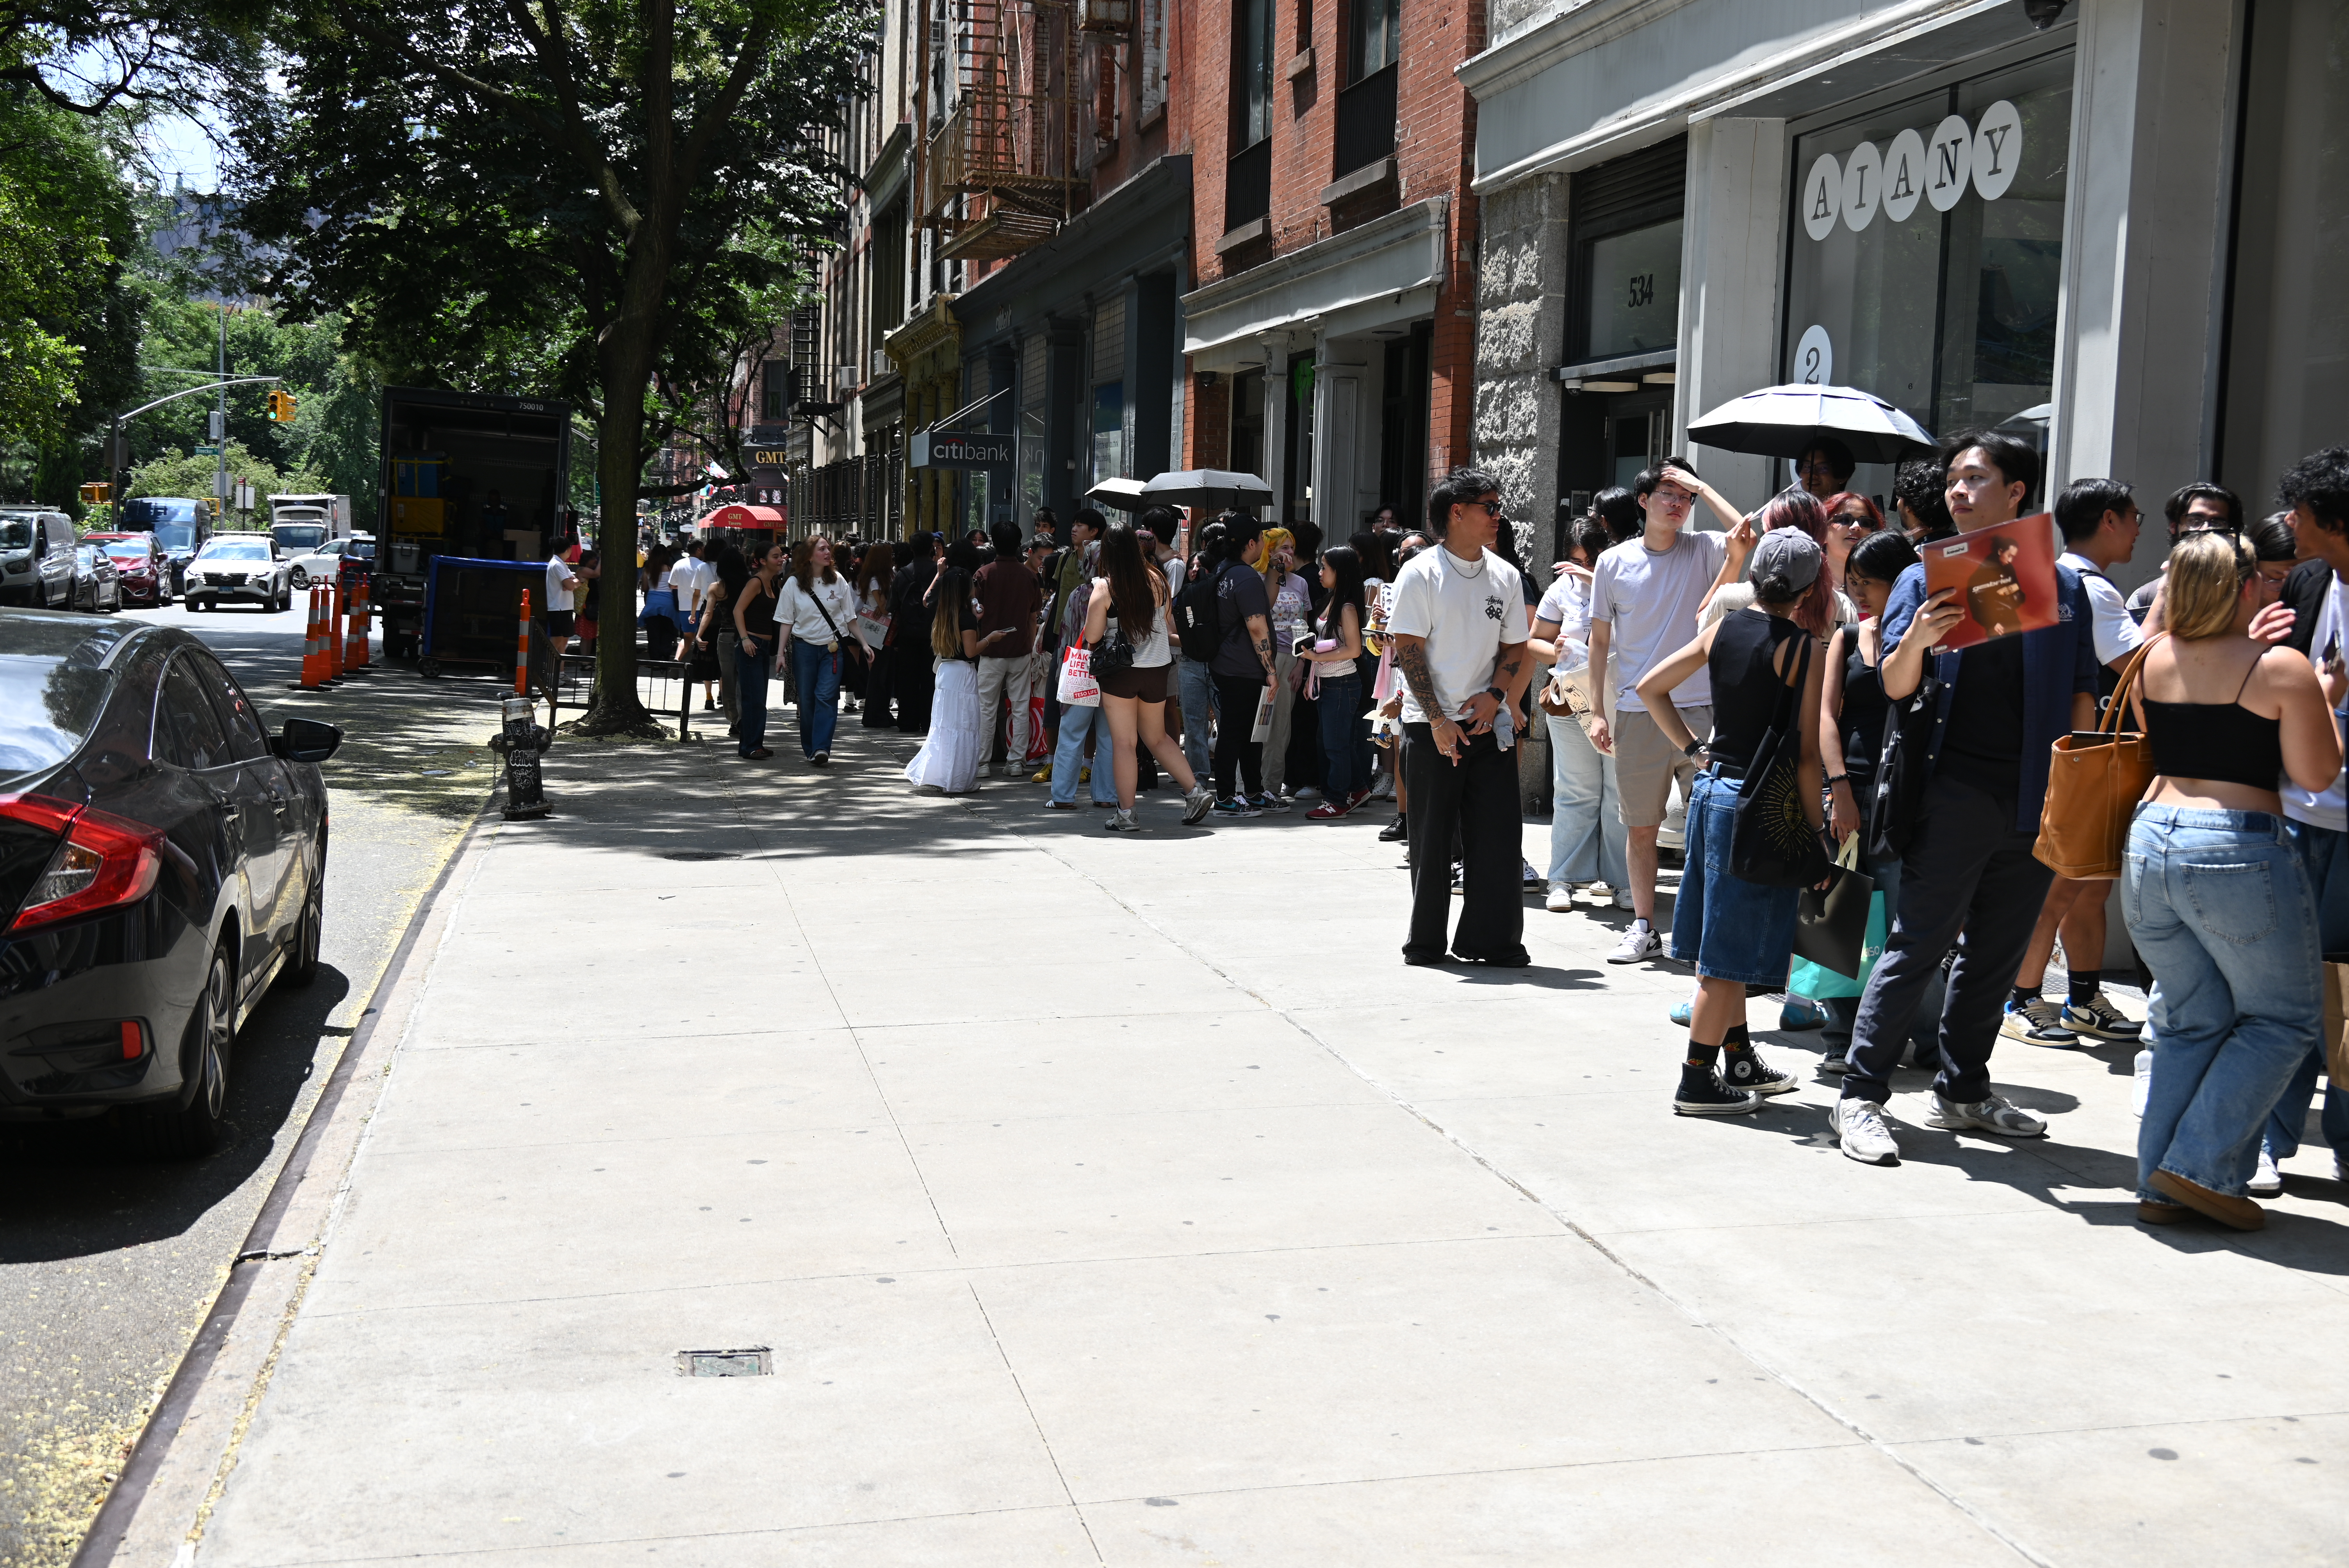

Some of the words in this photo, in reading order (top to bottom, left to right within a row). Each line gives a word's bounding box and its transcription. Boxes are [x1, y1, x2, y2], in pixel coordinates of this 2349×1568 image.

[1811, 124, 2011, 220] AIANY
[1628, 274, 1654, 308] 534
[1805, 347, 1820, 385] 2
[519, 402, 544, 412] 750010
[756, 451, 786, 464] GMT
[933, 442, 1008, 461] citibank
[1071, 652, 1089, 661] MAK
[1069, 661, 1085, 669] LIFE
[1068, 669, 1096, 679] BETTE
[1066, 677, 1091, 687] MAKE
[1064, 693, 1098, 705] BETTER
